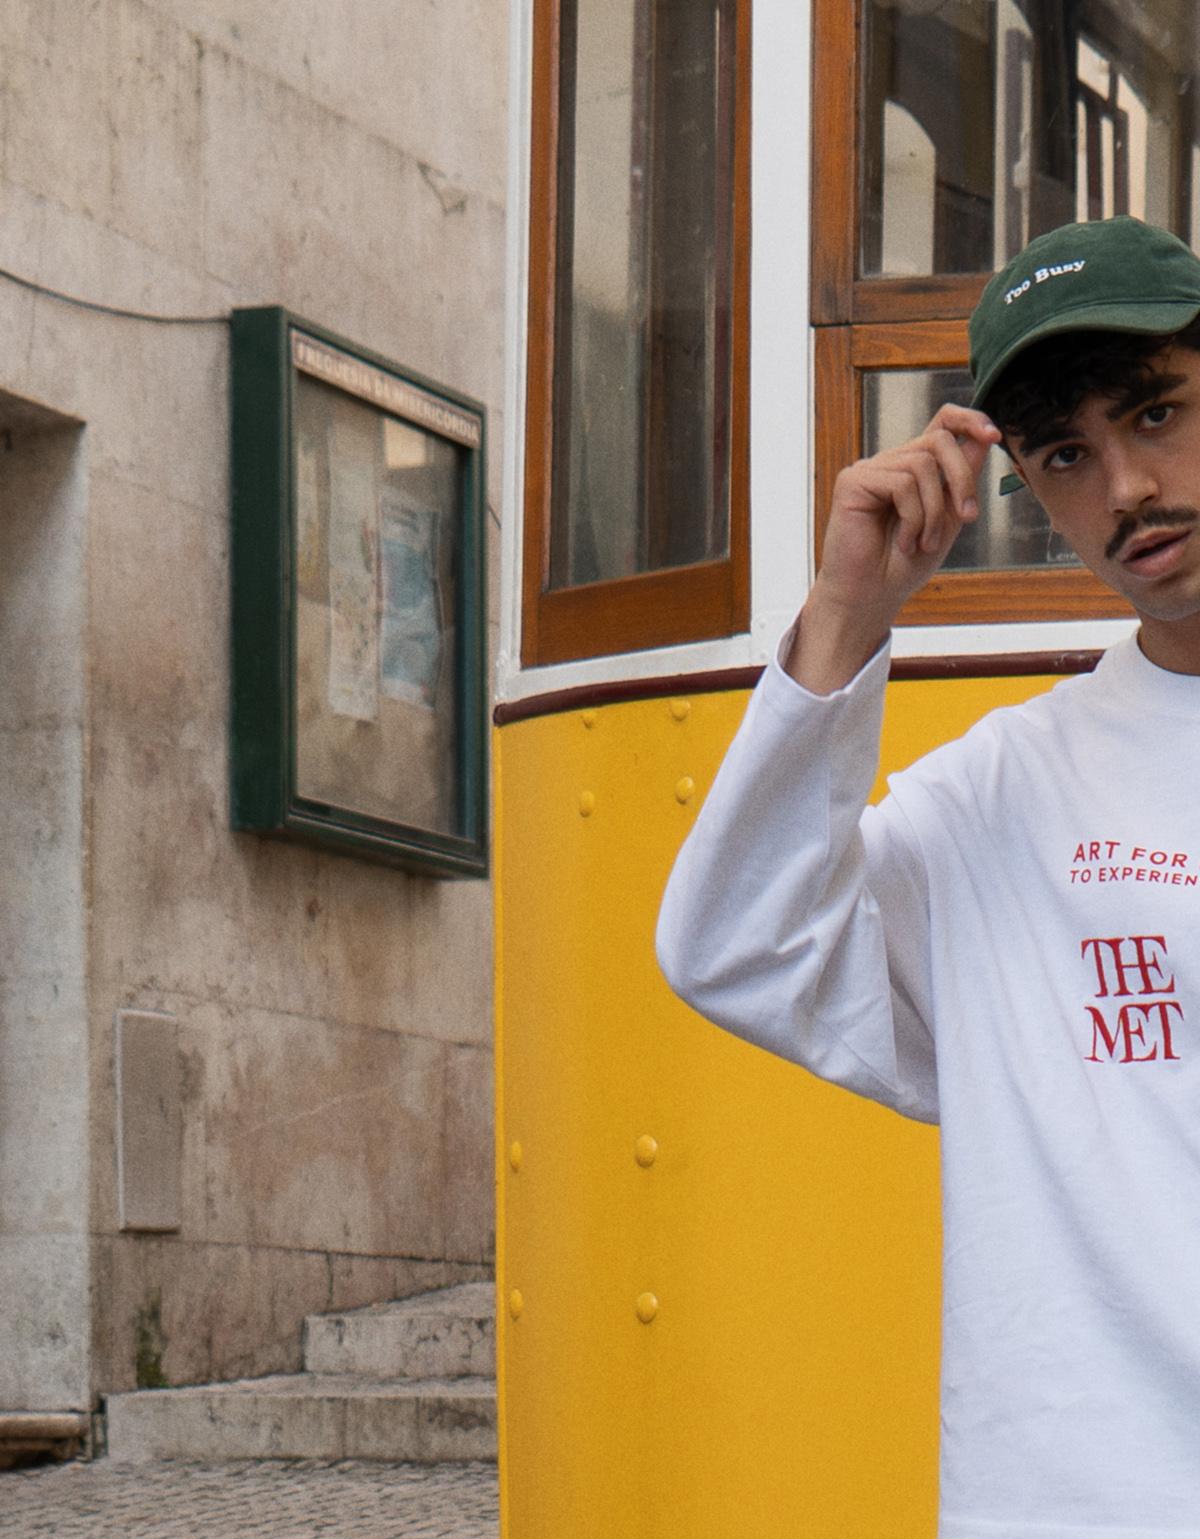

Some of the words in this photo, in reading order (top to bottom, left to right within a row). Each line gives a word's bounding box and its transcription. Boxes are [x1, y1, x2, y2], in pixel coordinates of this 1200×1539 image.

[1004, 280, 1031, 305] Too
[1034, 260, 1086, 283] Busy
[1070, 868, 1092, 883] TO
[1073, 841, 1120, 862] ART
[1131, 847, 1188, 868] FOR
[1081, 935, 1175, 998] THE
[1084, 1001, 1184, 1064] MET
